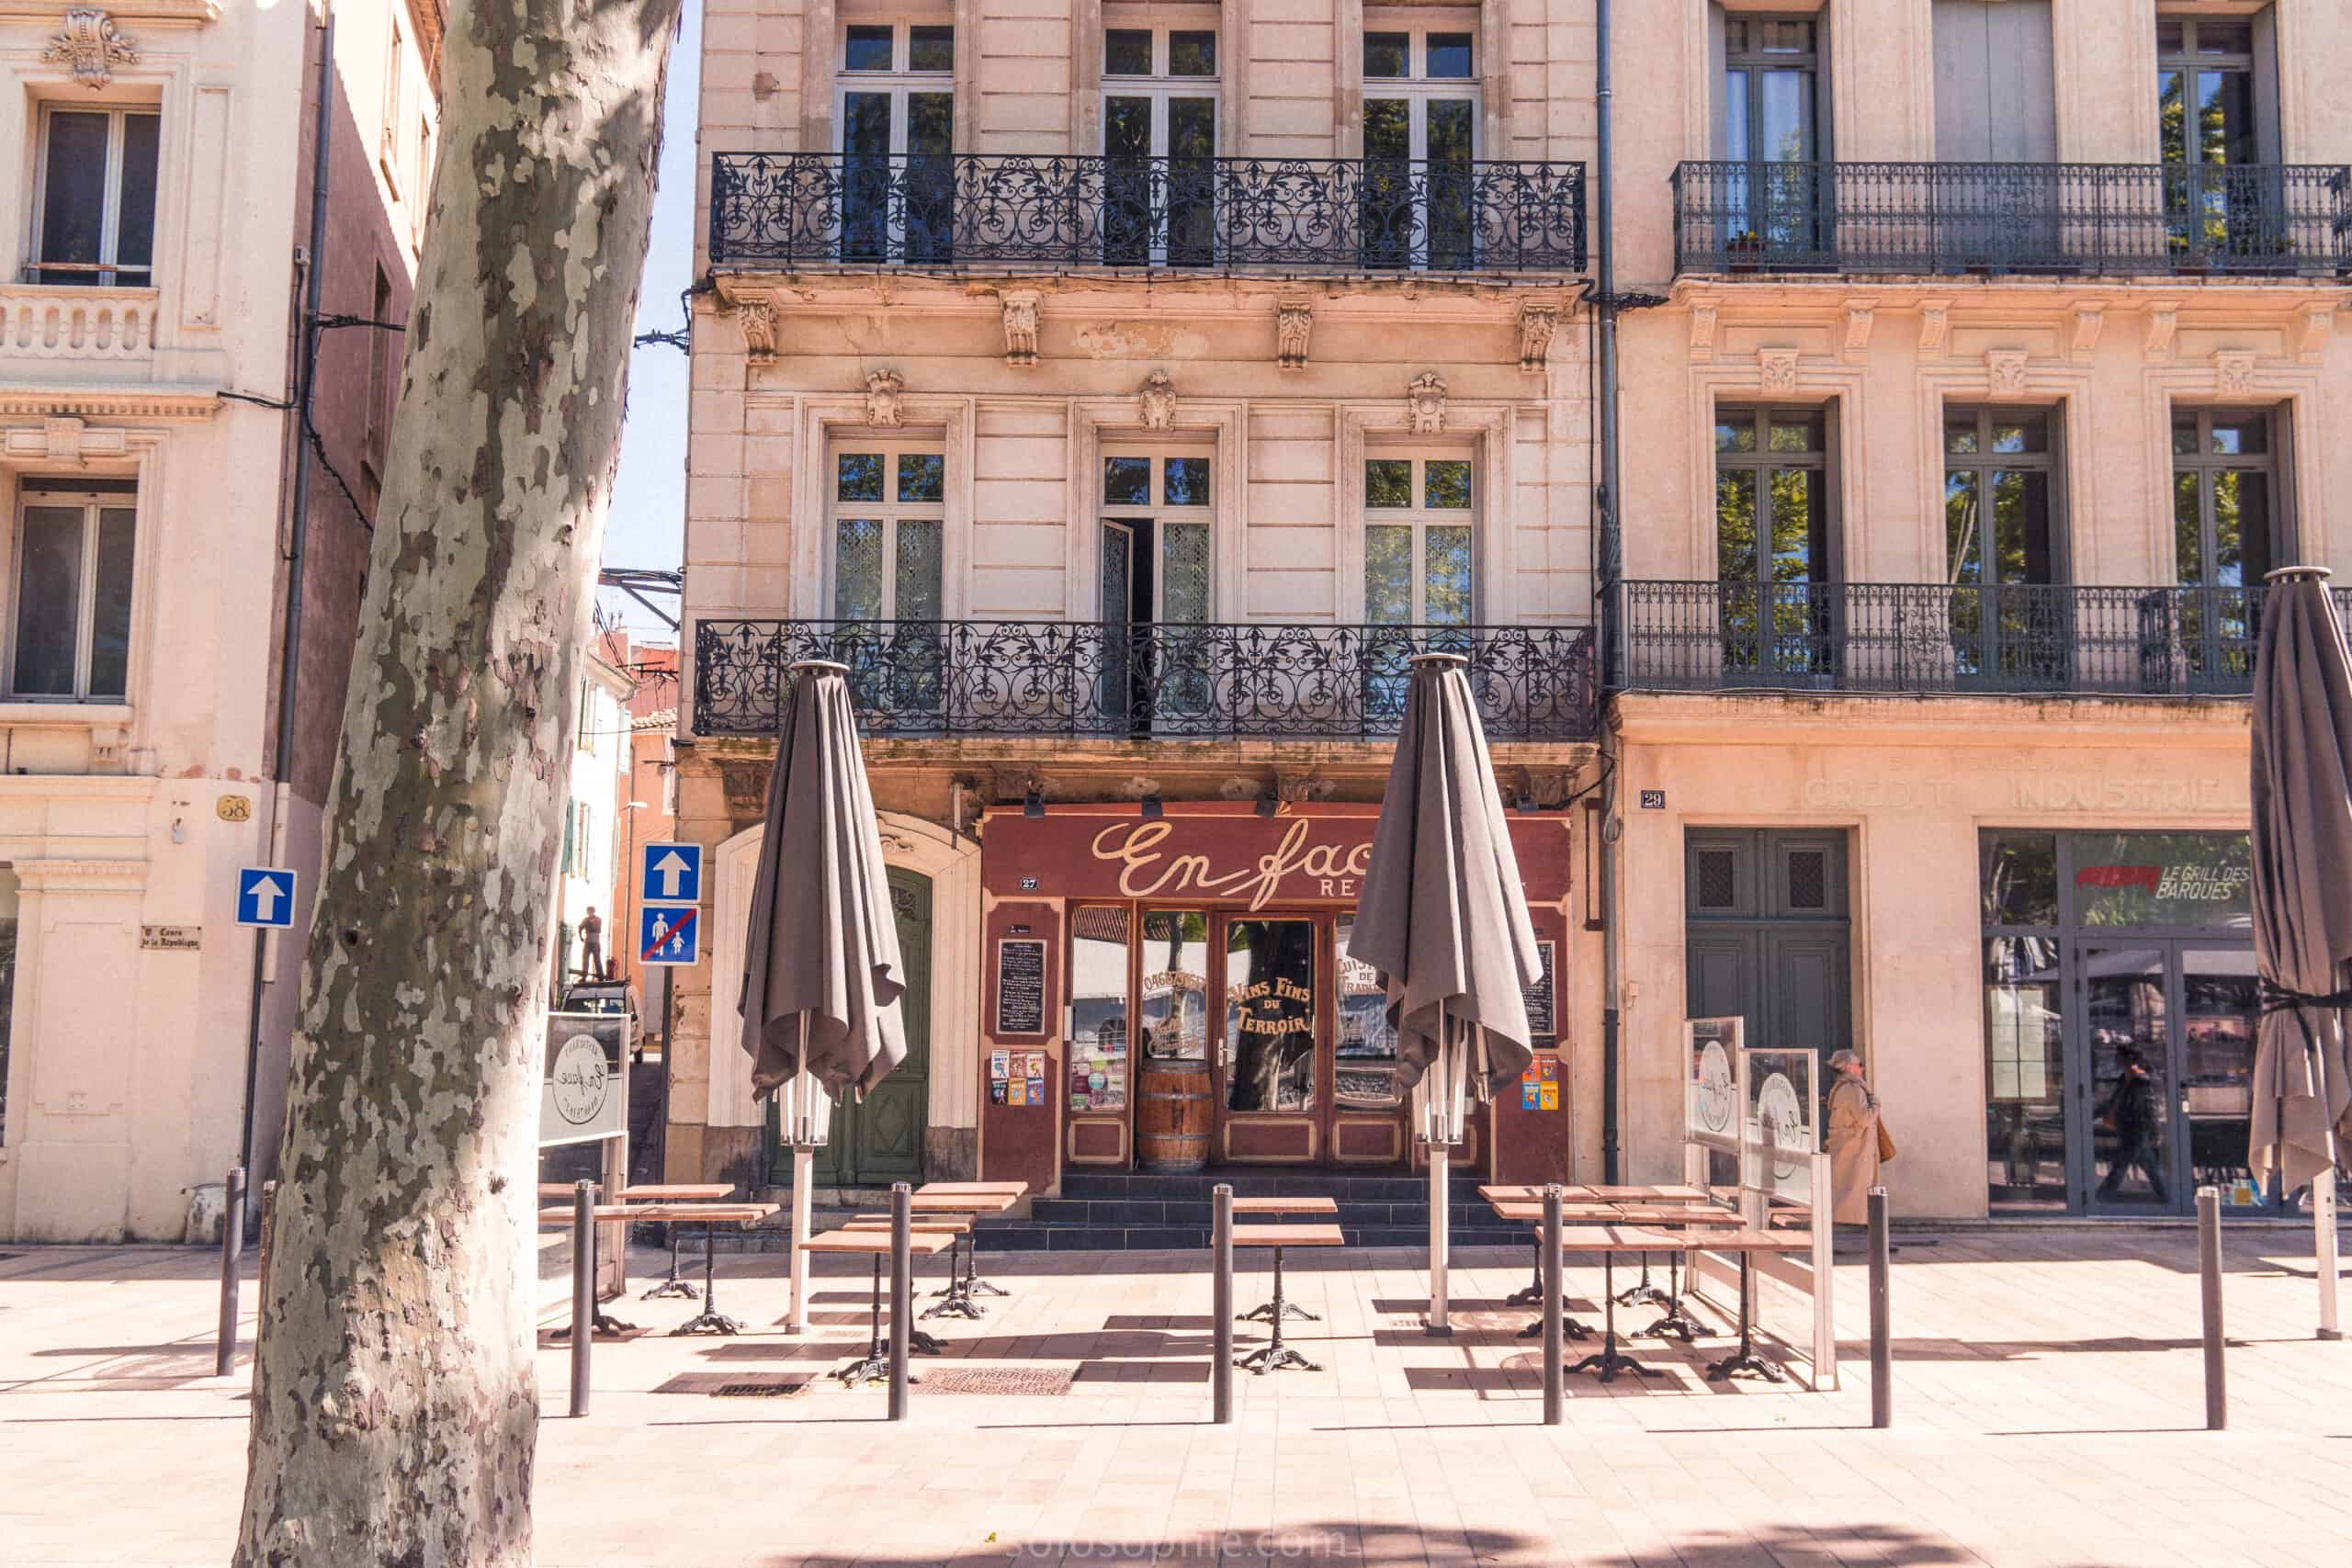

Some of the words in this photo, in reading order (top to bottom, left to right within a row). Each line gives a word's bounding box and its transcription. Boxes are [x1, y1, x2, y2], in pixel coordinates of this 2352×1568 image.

[1645, 793, 1662, 807] 29
[1091, 821, 1250, 897] En
[1220, 818, 1374, 911] fac
[2160, 866, 2178, 882] LE
[2178, 866, 2221, 882] GRILL
[2222, 866, 2250, 882] DES
[1021, 879, 1036, 888] 27
[2154, 882, 2233, 900] BARQUES
[1359, 972, 1374, 981] DE
[1263, 999, 1281, 1010] DU
